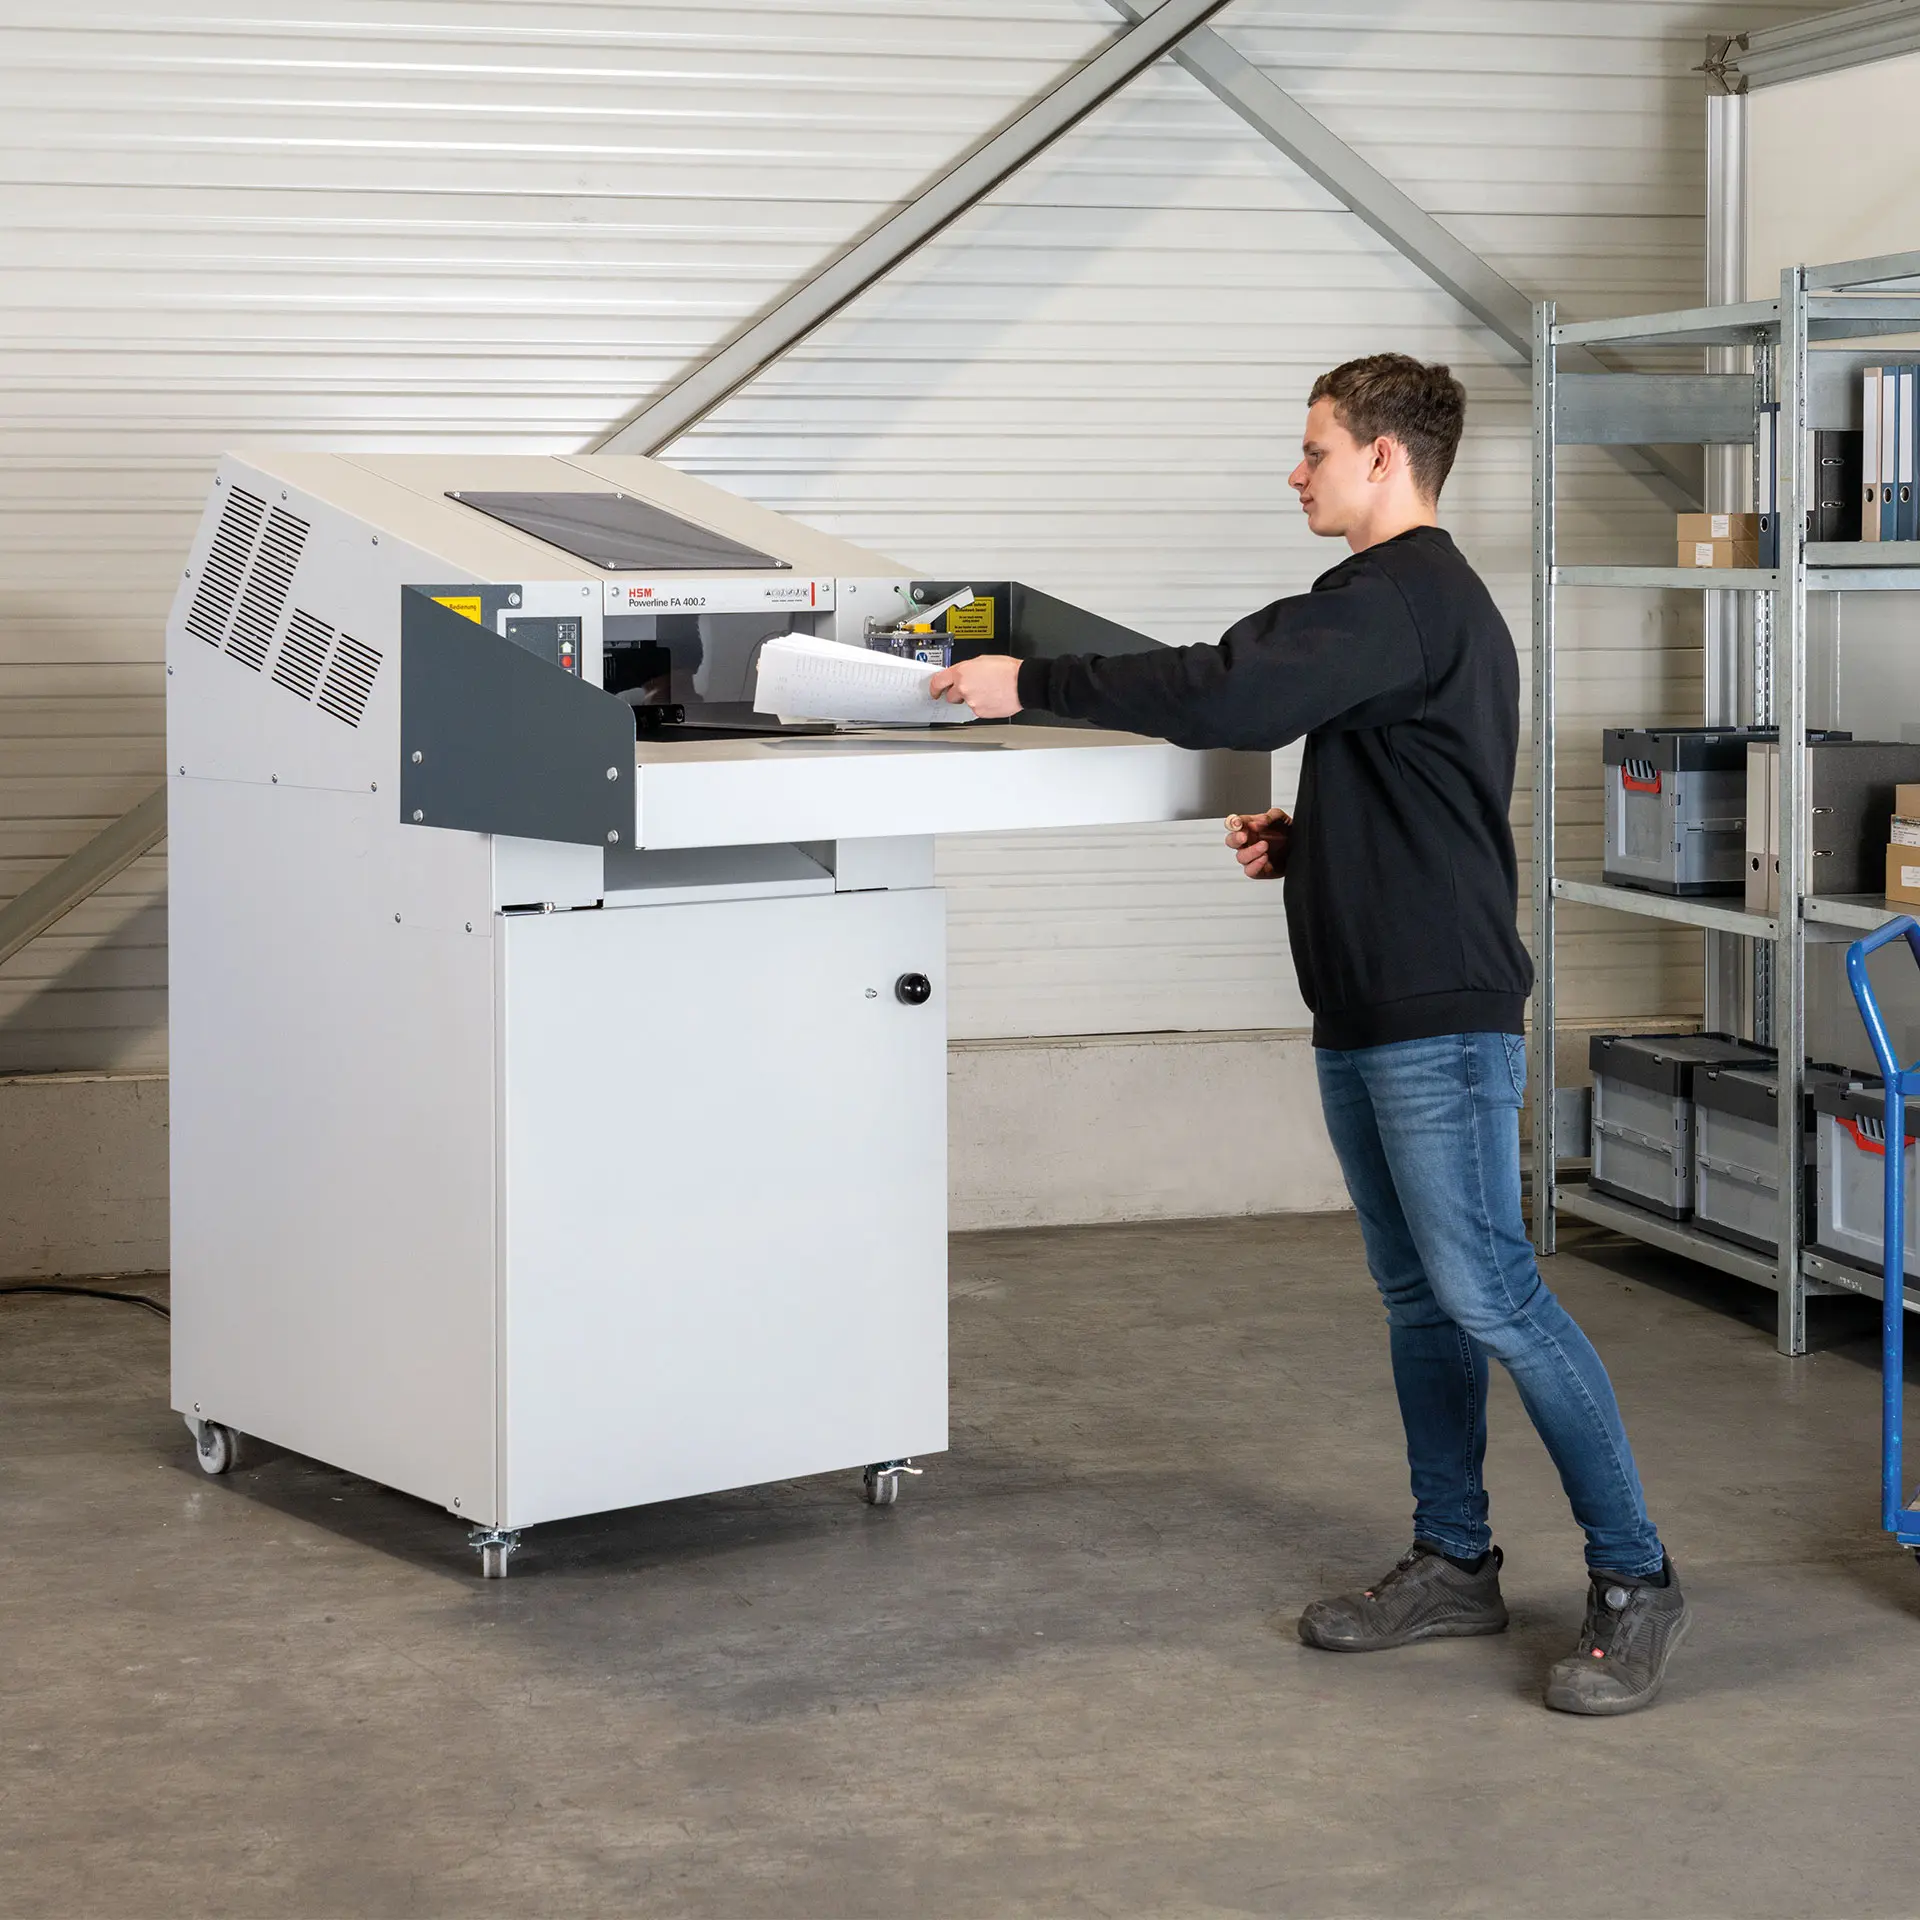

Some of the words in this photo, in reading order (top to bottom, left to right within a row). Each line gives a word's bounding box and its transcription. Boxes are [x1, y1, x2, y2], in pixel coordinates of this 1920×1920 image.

[629, 598, 668, 607] Powerline
[670, 598, 681, 606] FA
[683, 597, 706, 606] 400.2
